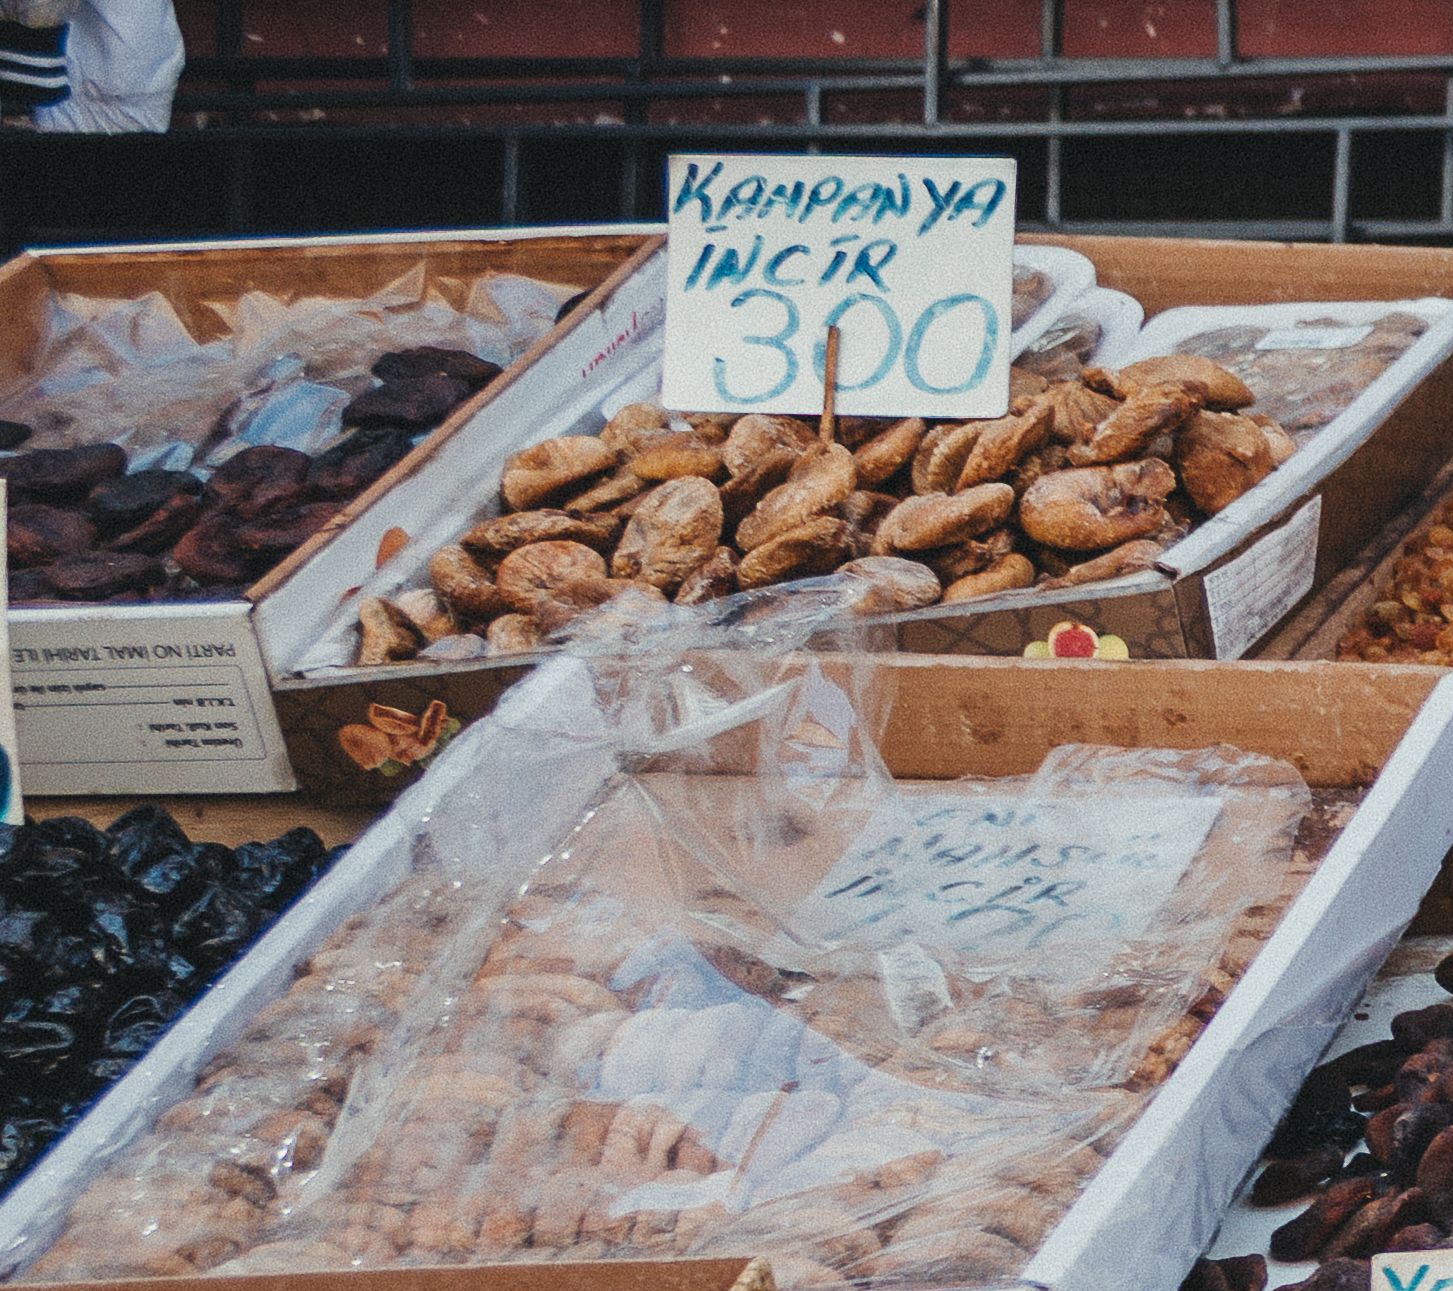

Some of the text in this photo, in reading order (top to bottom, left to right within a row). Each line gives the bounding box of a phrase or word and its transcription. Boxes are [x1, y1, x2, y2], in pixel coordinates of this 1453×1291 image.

[672, 161, 1007, 237] KAMPANYA
[683, 225, 899, 292] İNCİR
[712, 288, 999, 404] 300
[153, 644, 184, 659] NO
